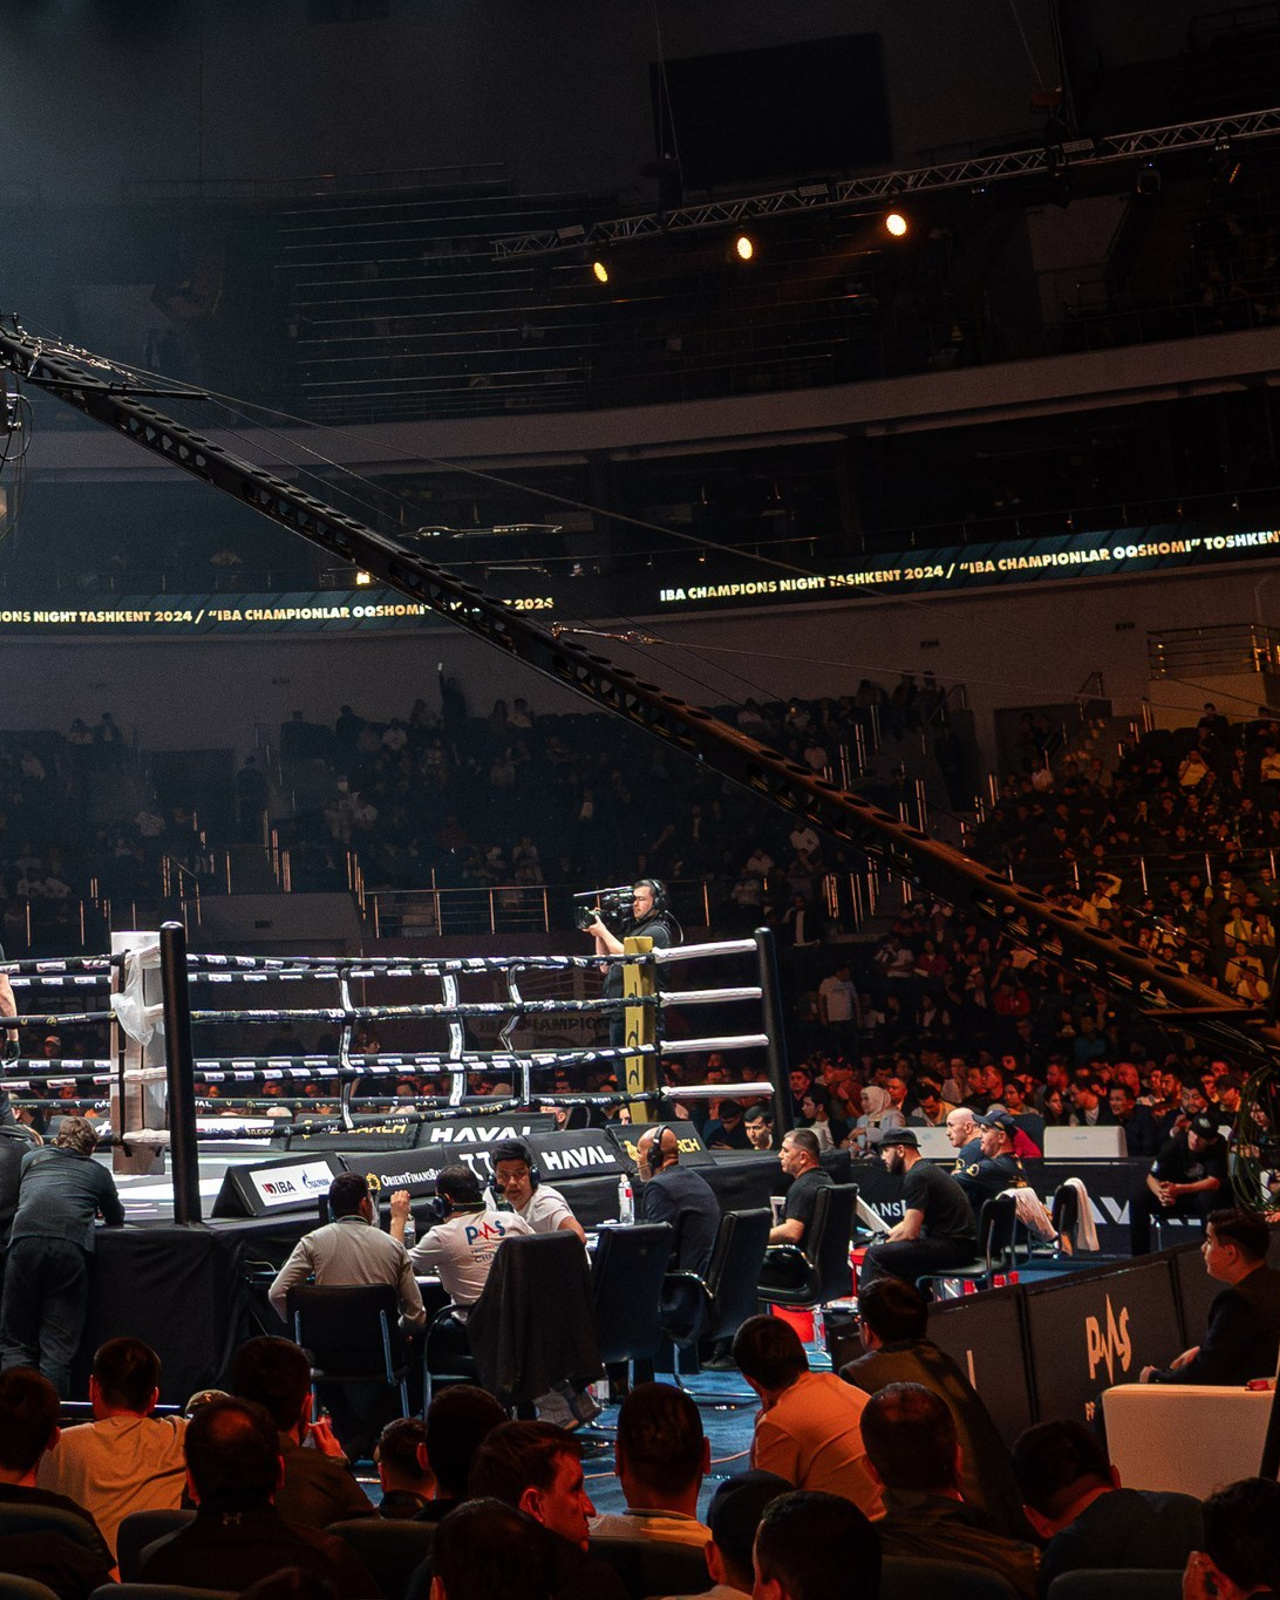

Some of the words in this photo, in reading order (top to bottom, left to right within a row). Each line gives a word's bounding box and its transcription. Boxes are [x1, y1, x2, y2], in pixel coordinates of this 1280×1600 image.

[660, 588, 687, 602] IBA
[687, 580, 778, 600] CHAMPIONS
[779, 576, 827, 592] NIGHT
[827, 570, 902, 588] TASHKENT
[903, 564, 944, 580] 2024
[997, 547, 1111, 571] CHAMPIONLAR
[1203, 530, 1280, 551] TOSHKEN
[33, 610, 78, 623] NIGHT
[79, 610, 152, 623] TASHKENT
[153, 610, 193, 623] 2024
[244, 606, 351, 621] CHAMPIONLAR
[540, 1145, 616, 1171] HAVAL
[275, 1180, 297, 1194] IBA
